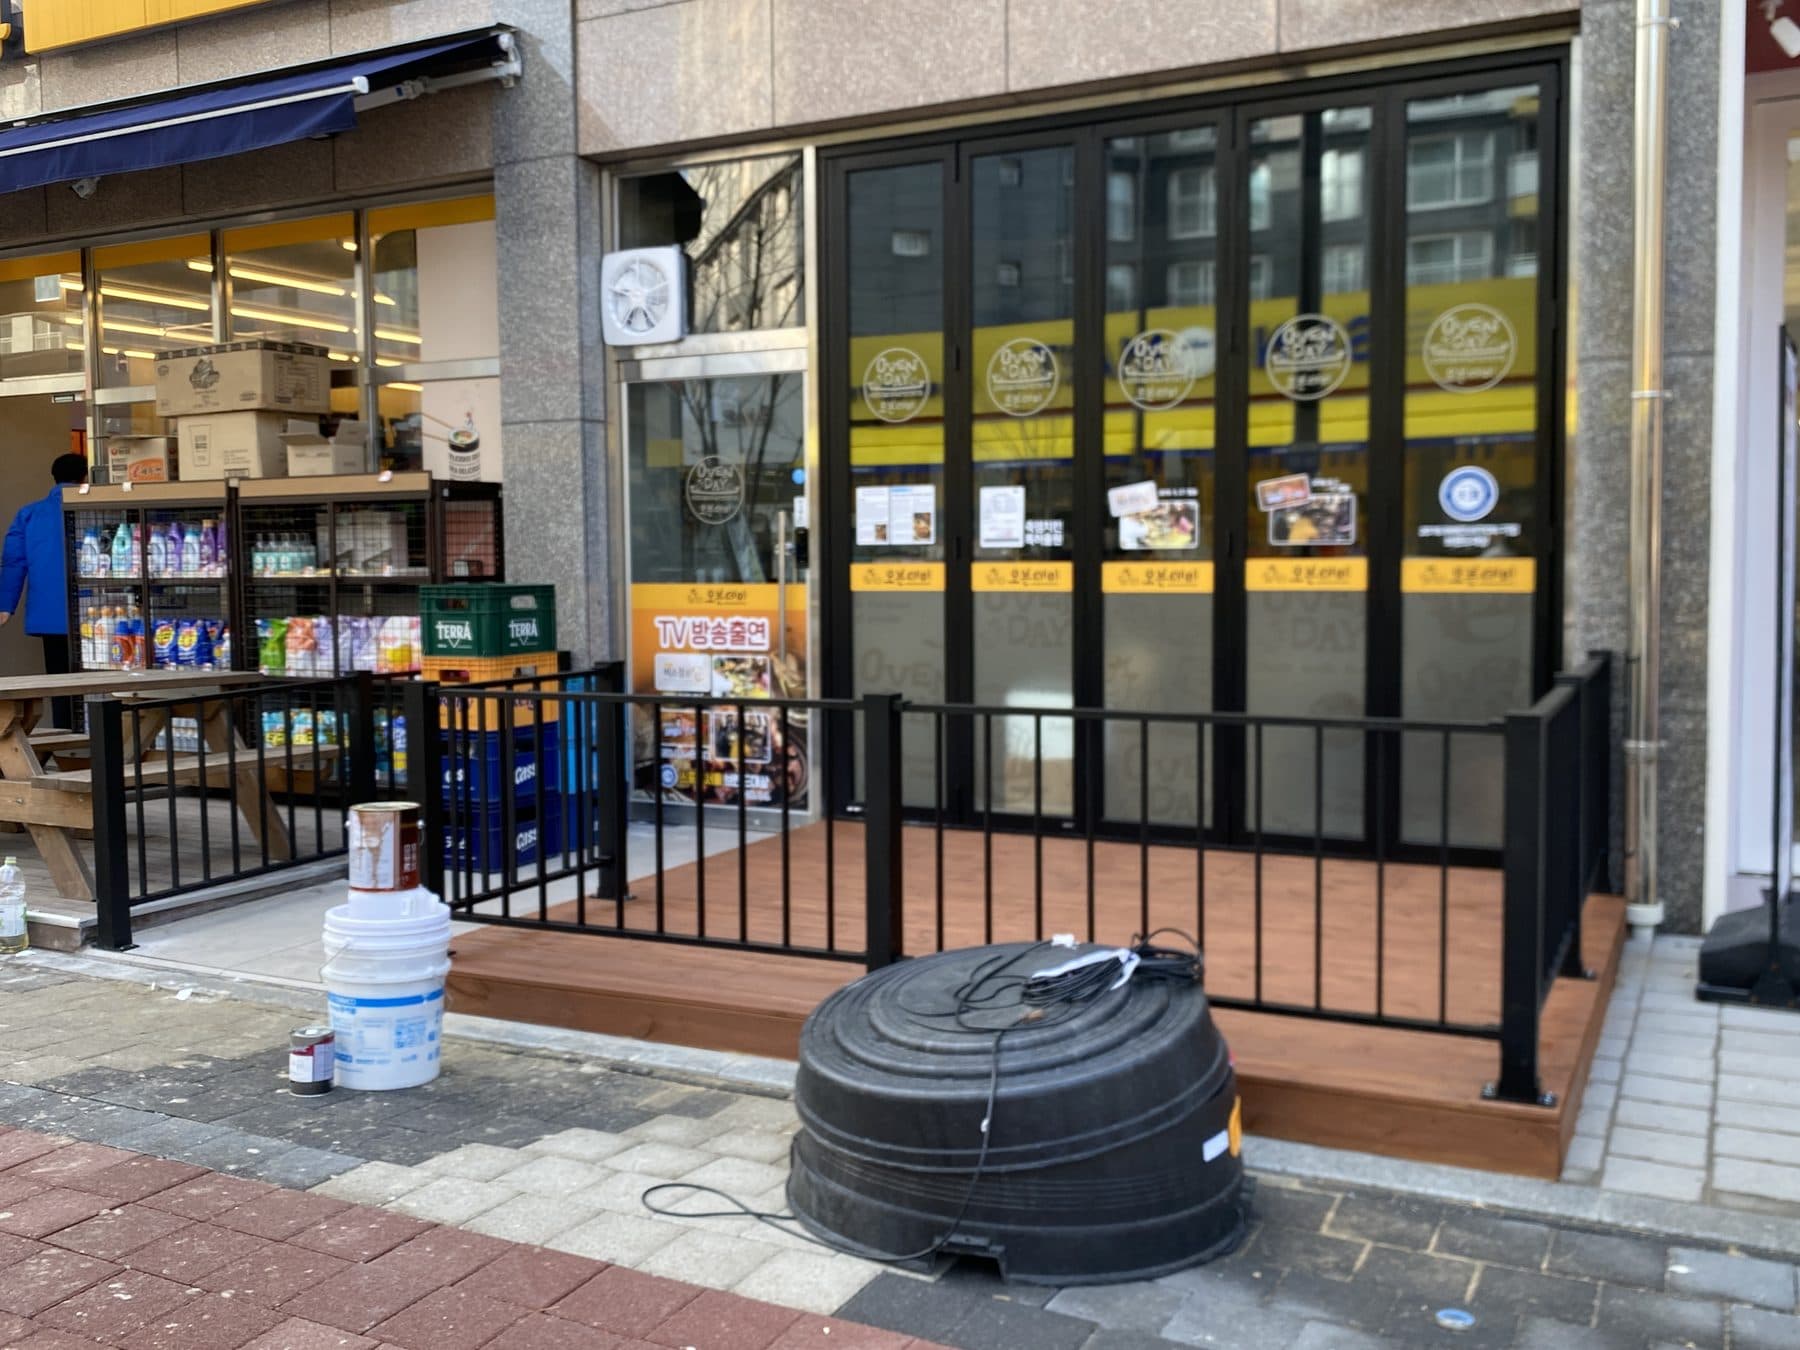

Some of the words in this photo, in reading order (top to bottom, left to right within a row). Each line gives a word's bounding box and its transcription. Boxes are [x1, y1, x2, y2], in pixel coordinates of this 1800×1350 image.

[435, 621, 472, 640] TERRA
[508, 619, 538, 638] TERRA
[657, 620, 686, 645] TV
[691, 619, 766, 646] 방송출연
